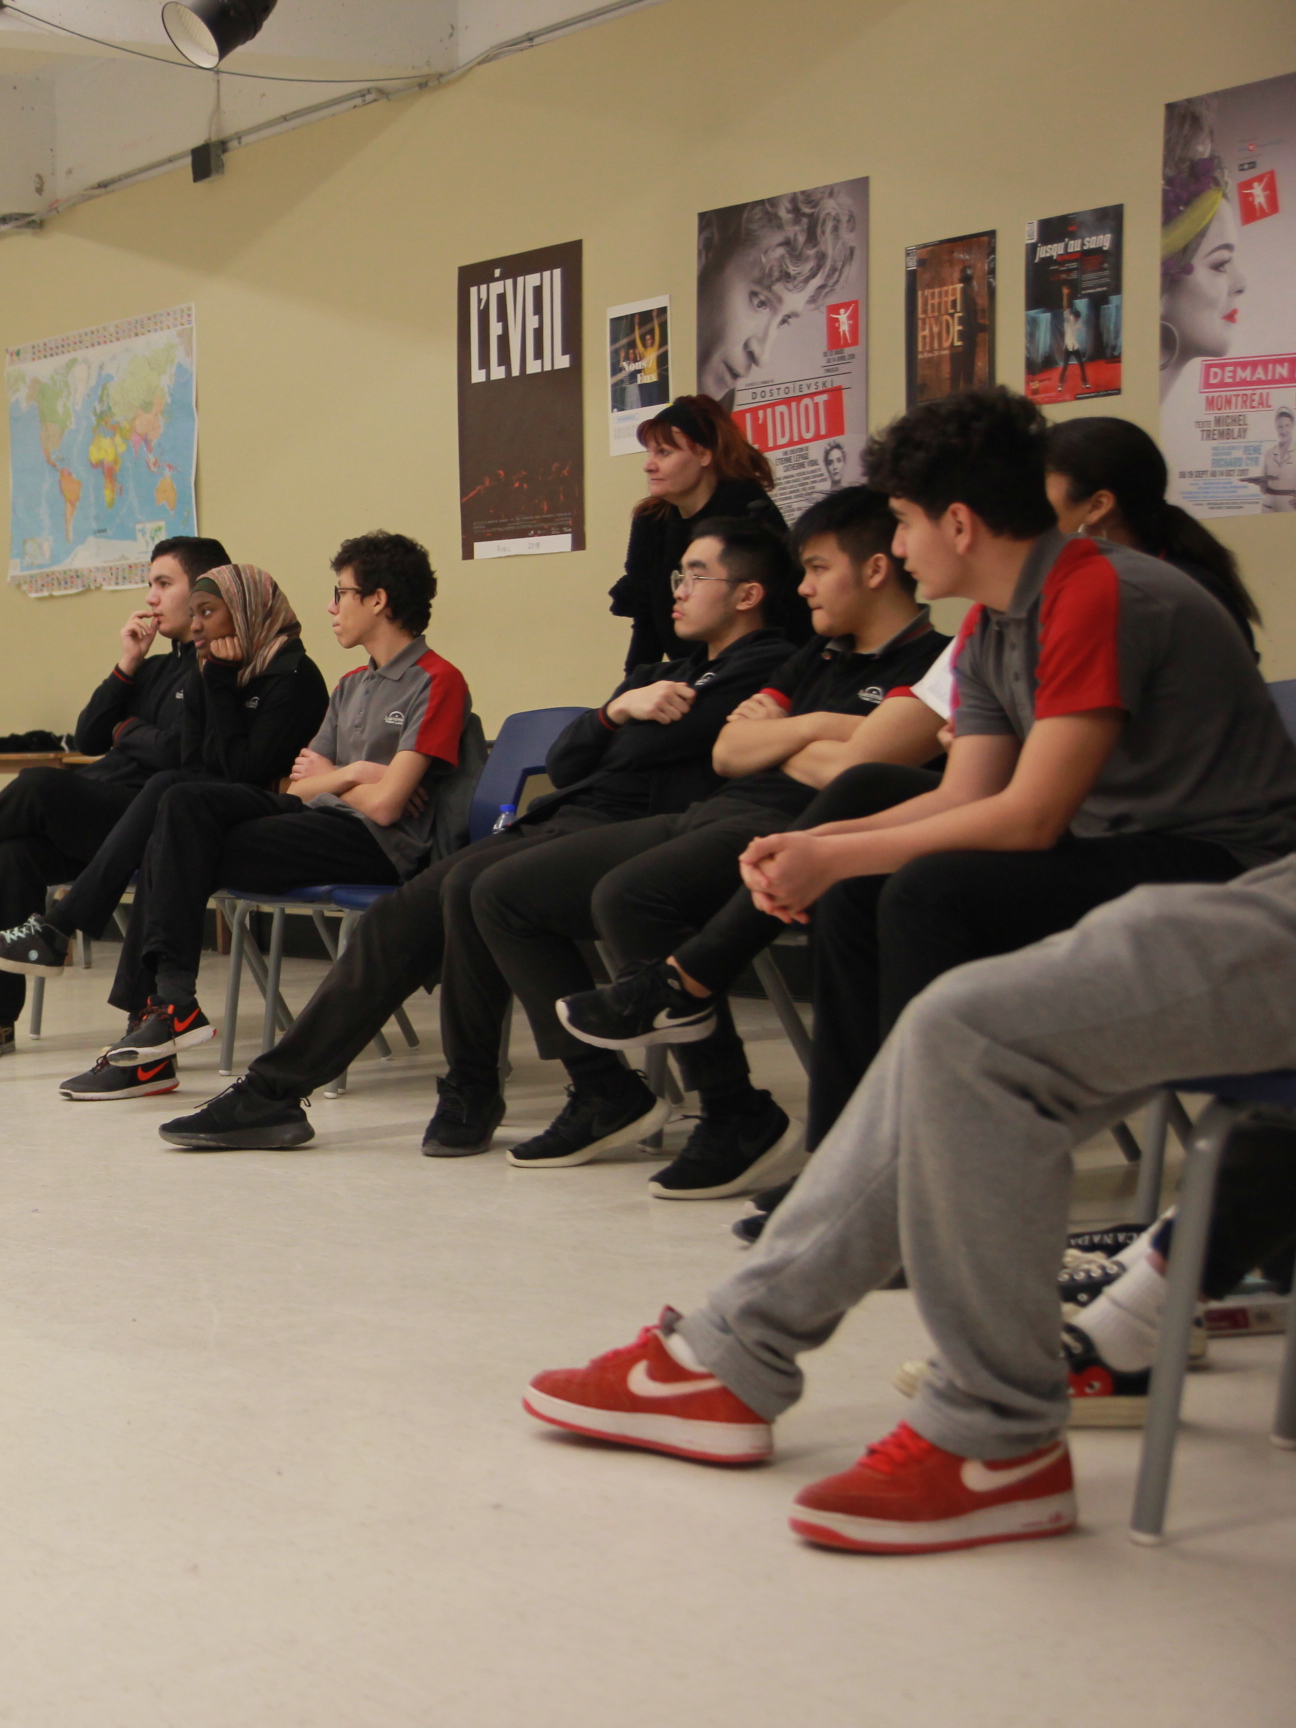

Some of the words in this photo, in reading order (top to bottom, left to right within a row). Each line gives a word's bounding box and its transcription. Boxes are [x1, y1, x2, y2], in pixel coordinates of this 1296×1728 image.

[1034, 238, 1082, 262] jusqu'au
[1083, 233, 1112, 250] sang
[918, 283, 964, 319] L'EFFET
[470, 268, 570, 384] L'ÉVEIL
[918, 312, 963, 351] HYDE
[1208, 362, 1289, 384] DEMAIN
[751, 379, 835, 400] DOSTOÏEVSKI
[1205, 390, 1272, 411] MONTRÉAL
[745, 393, 829, 450] L'IDIOT
[1213, 414, 1249, 428] MICHEL
[1200, 427, 1248, 441] TREMBLAY
[1070, 1232, 1138, 1246] CANADA
